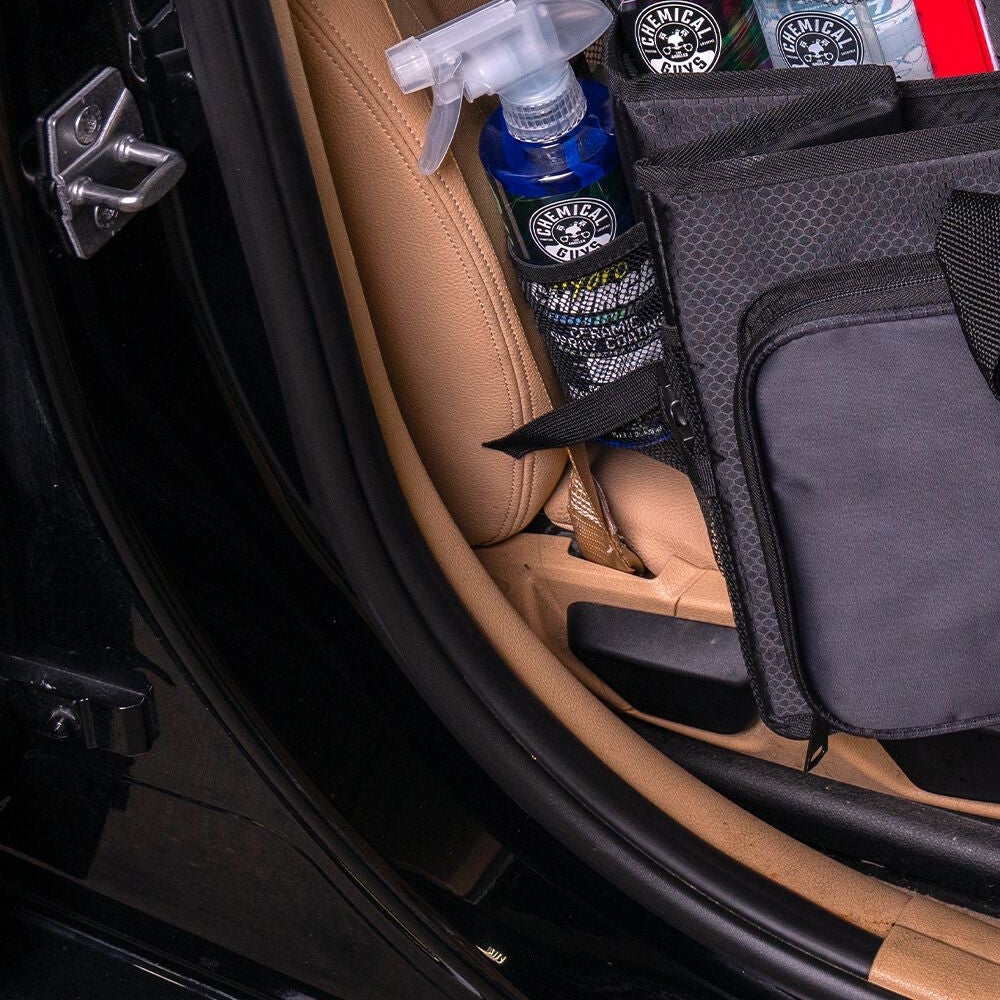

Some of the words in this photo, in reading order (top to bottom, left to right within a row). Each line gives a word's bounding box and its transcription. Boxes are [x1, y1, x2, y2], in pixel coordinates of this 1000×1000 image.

[641, 8, 712, 47] CHEMICAL
[782, 19, 853, 53] CHEMICAL
[661, 57, 708, 73] GUYS
[536, 203, 606, 236] CHEMICAL
